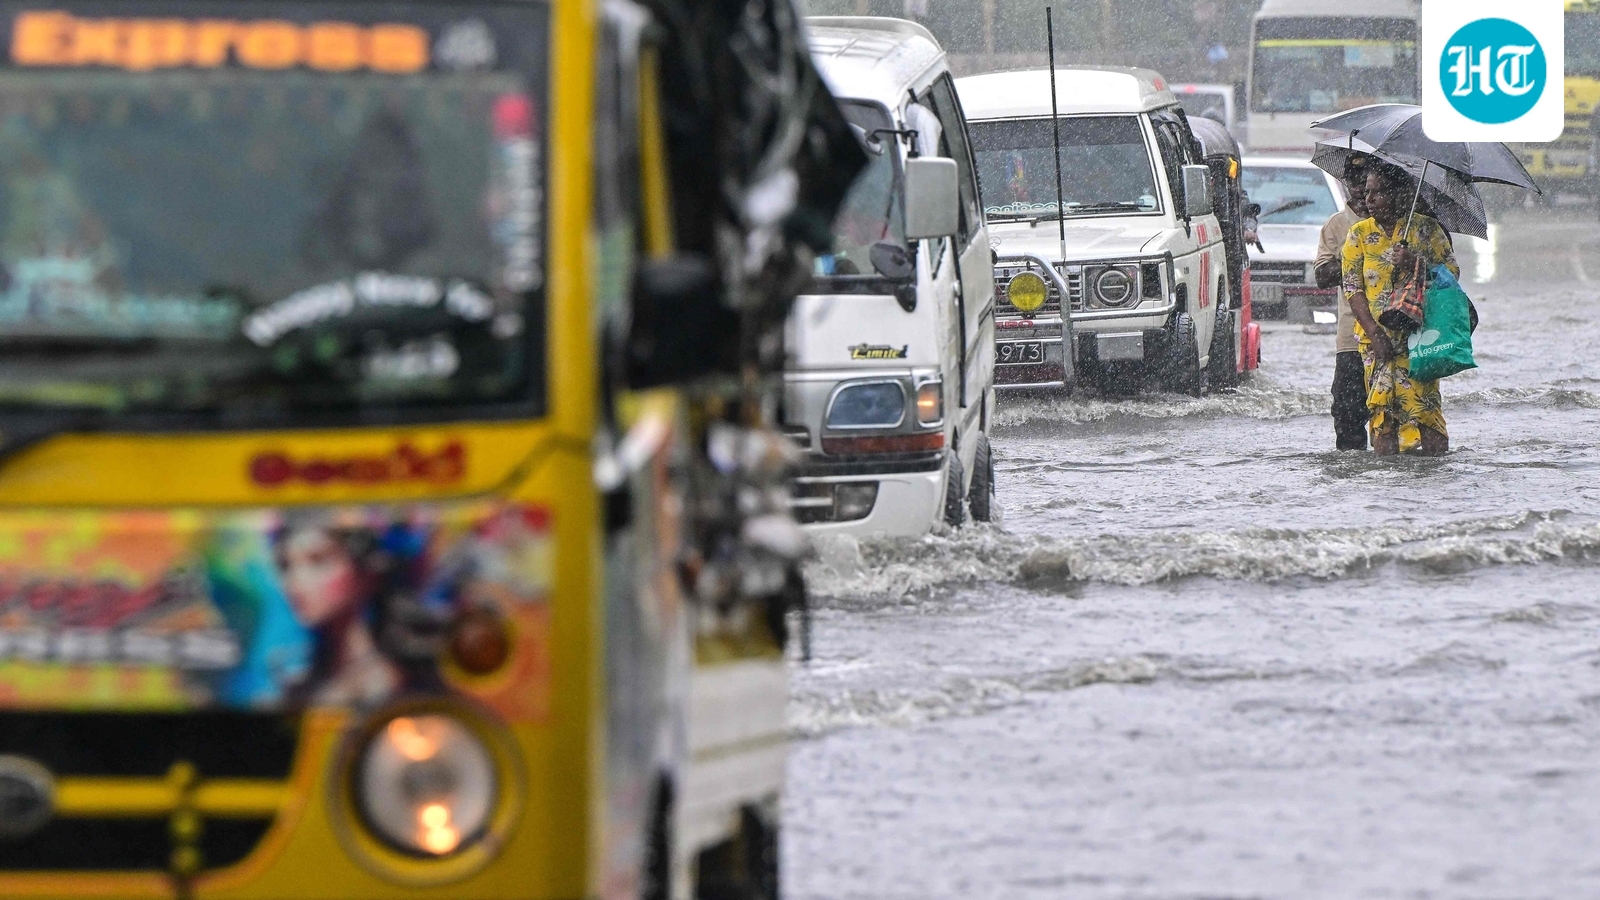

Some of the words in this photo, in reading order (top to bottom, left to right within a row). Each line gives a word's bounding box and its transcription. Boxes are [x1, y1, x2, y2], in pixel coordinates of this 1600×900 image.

[9, 10, 428, 72] Express
[1423, 347, 1432, 356] go
[1433, 343, 1454, 353] green
